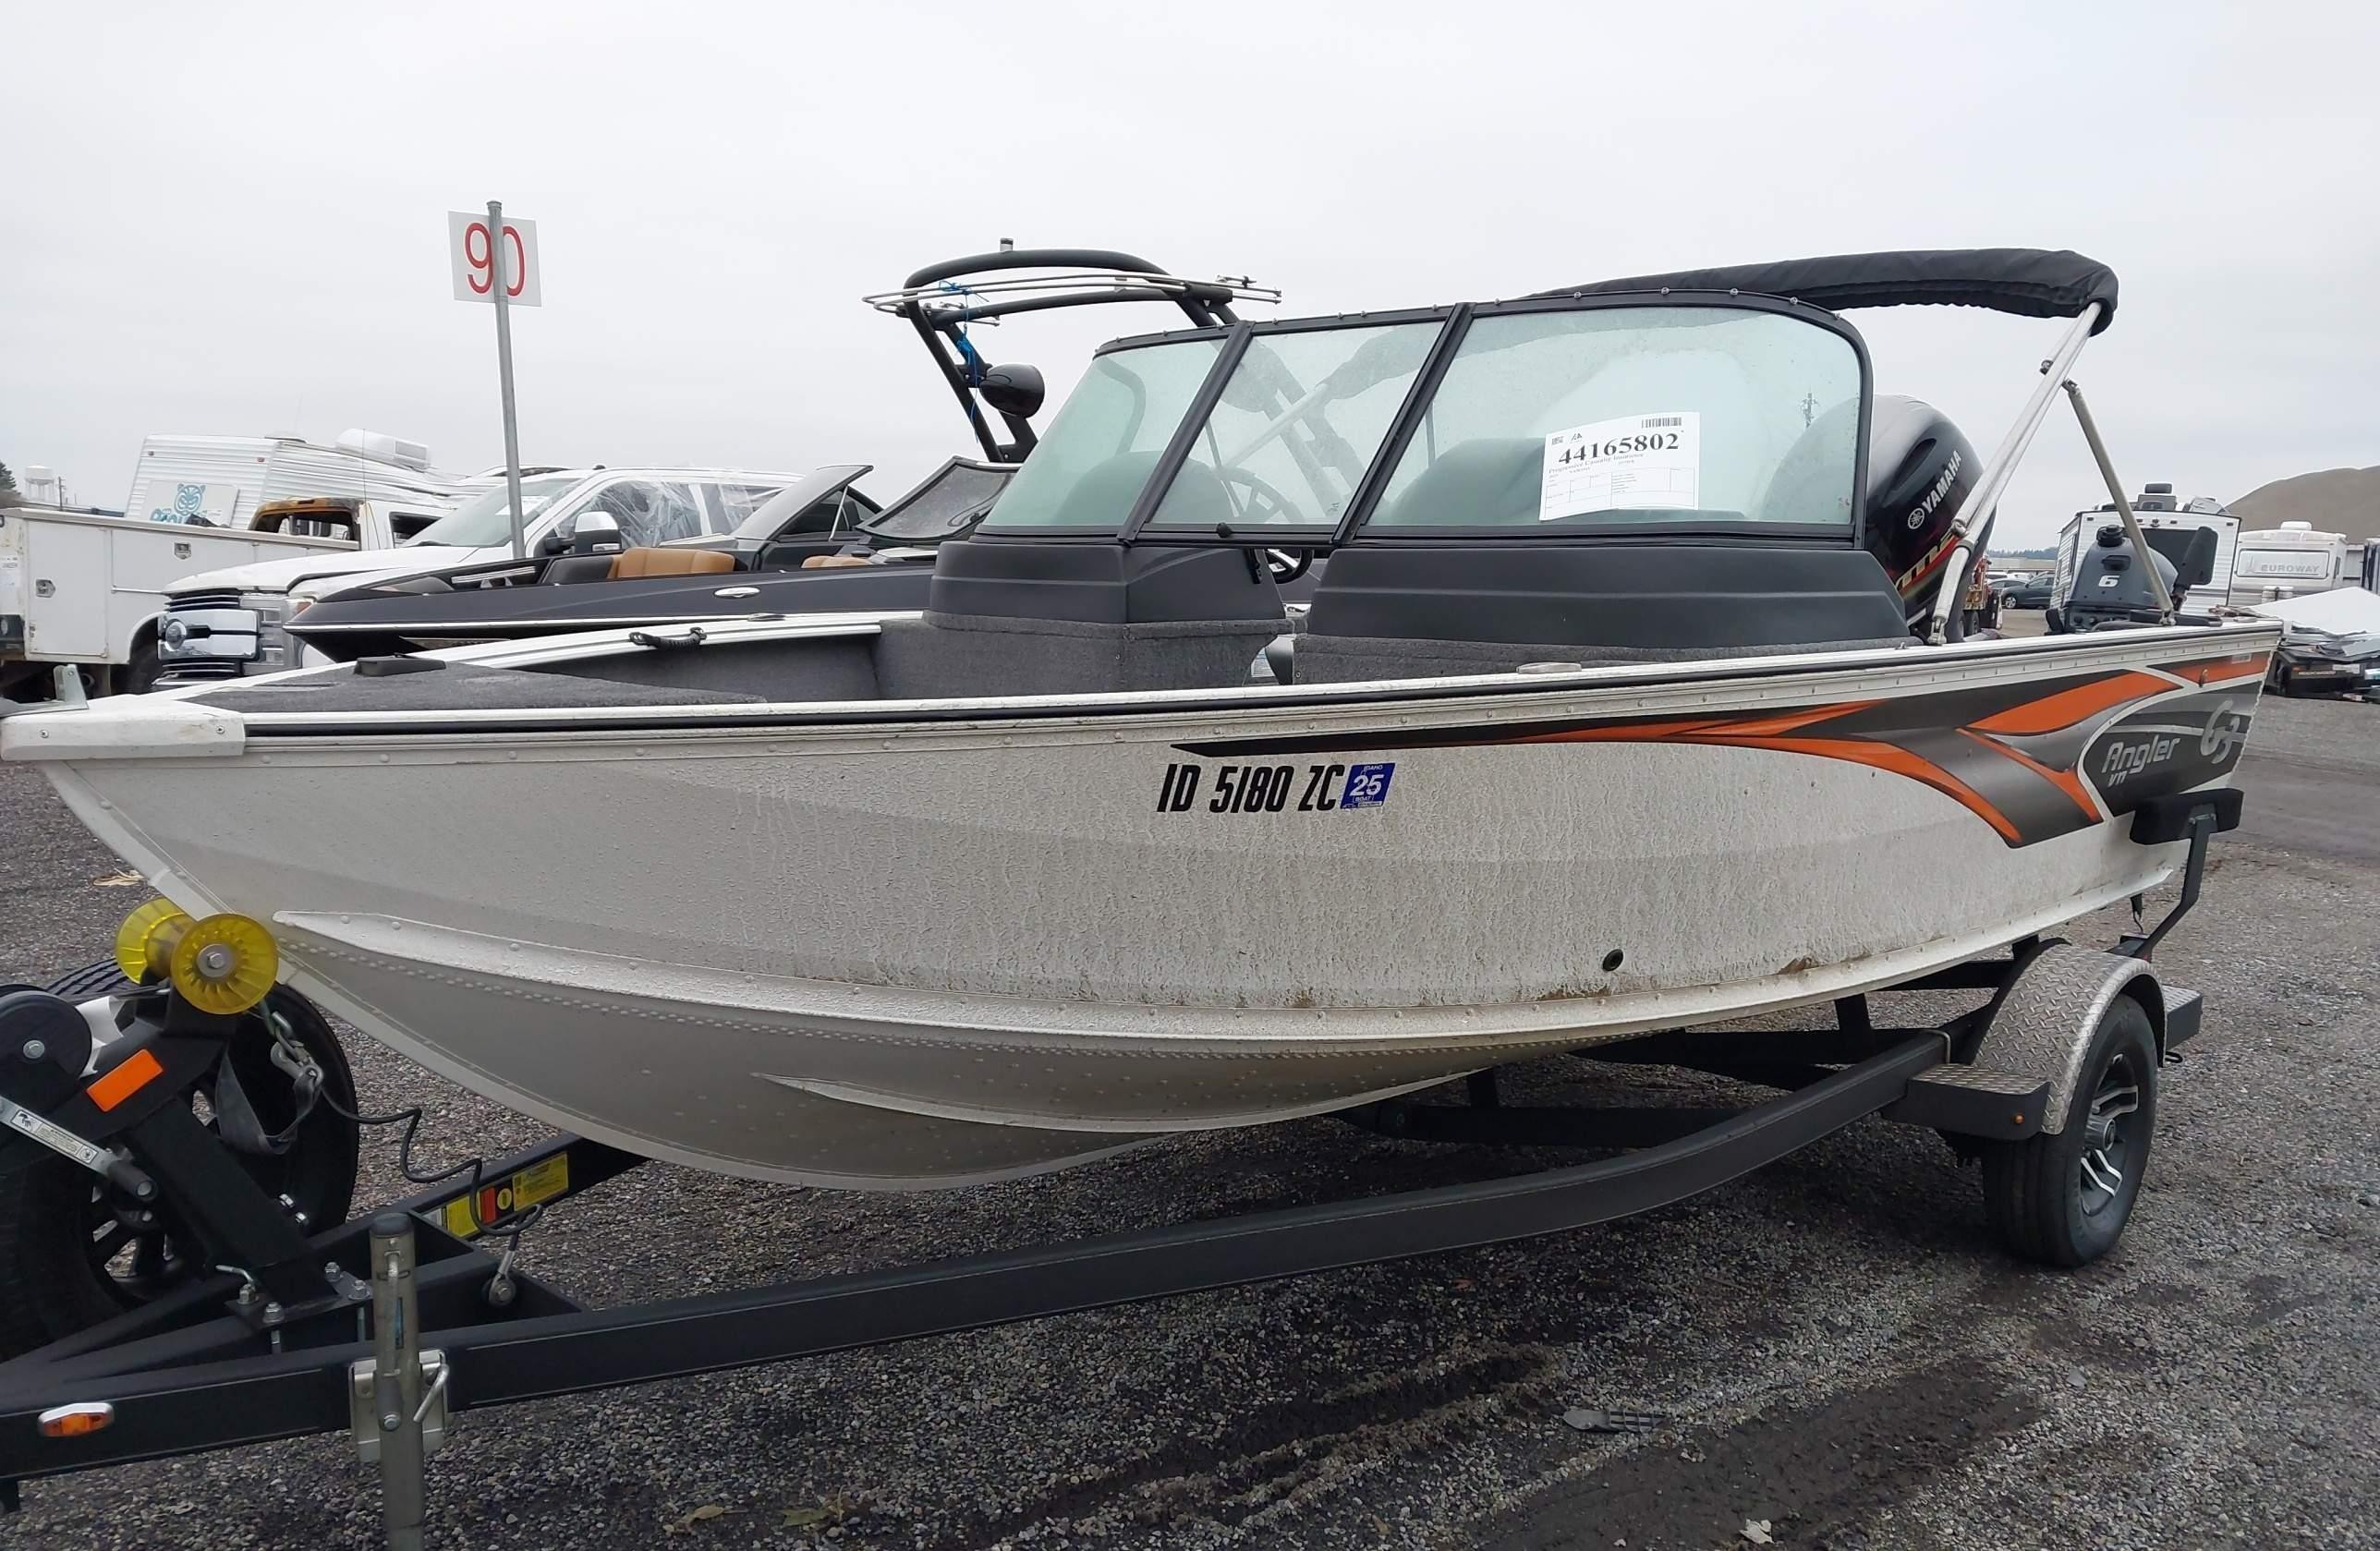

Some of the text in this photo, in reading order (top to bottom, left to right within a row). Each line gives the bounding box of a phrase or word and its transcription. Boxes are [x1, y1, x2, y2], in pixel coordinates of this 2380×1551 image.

[1558, 432, 1680, 464] 44165802
[1922, 450, 1962, 514] YAMAHA
[2098, 575, 2121, 588] 6
[2261, 563, 2320, 573] EUROWAY
[2101, 734, 2180, 774] Angler
[1157, 764, 1345, 813] ID 5180 ZC
[1349, 774, 1385, 796] 25
